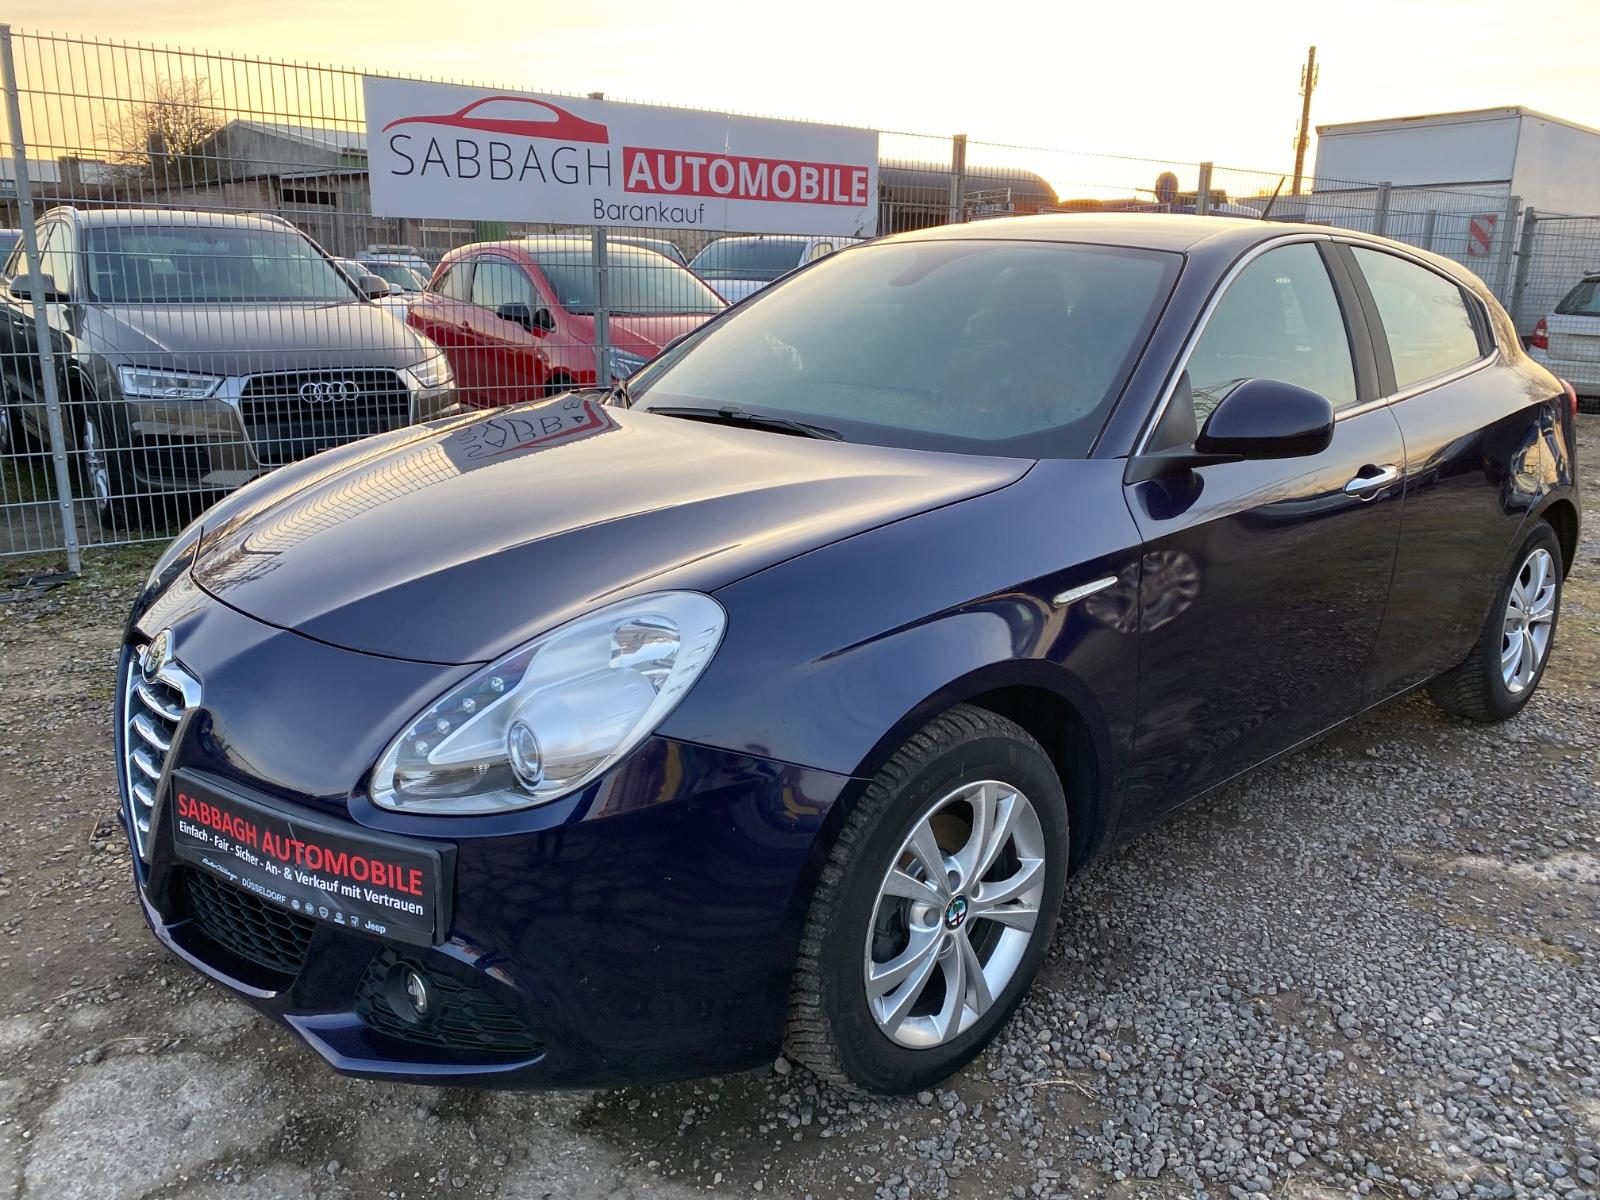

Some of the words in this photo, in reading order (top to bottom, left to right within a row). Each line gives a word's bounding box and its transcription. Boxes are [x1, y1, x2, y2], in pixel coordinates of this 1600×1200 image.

[389, 134, 611, 187] SABBAGH
[626, 151, 868, 204] AUTOMOBILE
[593, 198, 705, 224] Barankauf
[178, 793, 258, 848] SABBAGH
[262, 831, 423, 896] AUTOMOBILE
[179, 821, 208, 842] Einfach
[214, 835, 229, 851] Fair
[235, 845, 259, 867] Sicher
[265, 860, 282, 875] An-
[284, 867, 293, 880] &
[294, 870, 339, 893] Verkauf
[341, 884, 361, 899] mit
[363, 887, 424, 916] Vertrauen
[242, 878, 287, 903] DÜSSELDORF
[365, 920, 386, 935] Jeep
